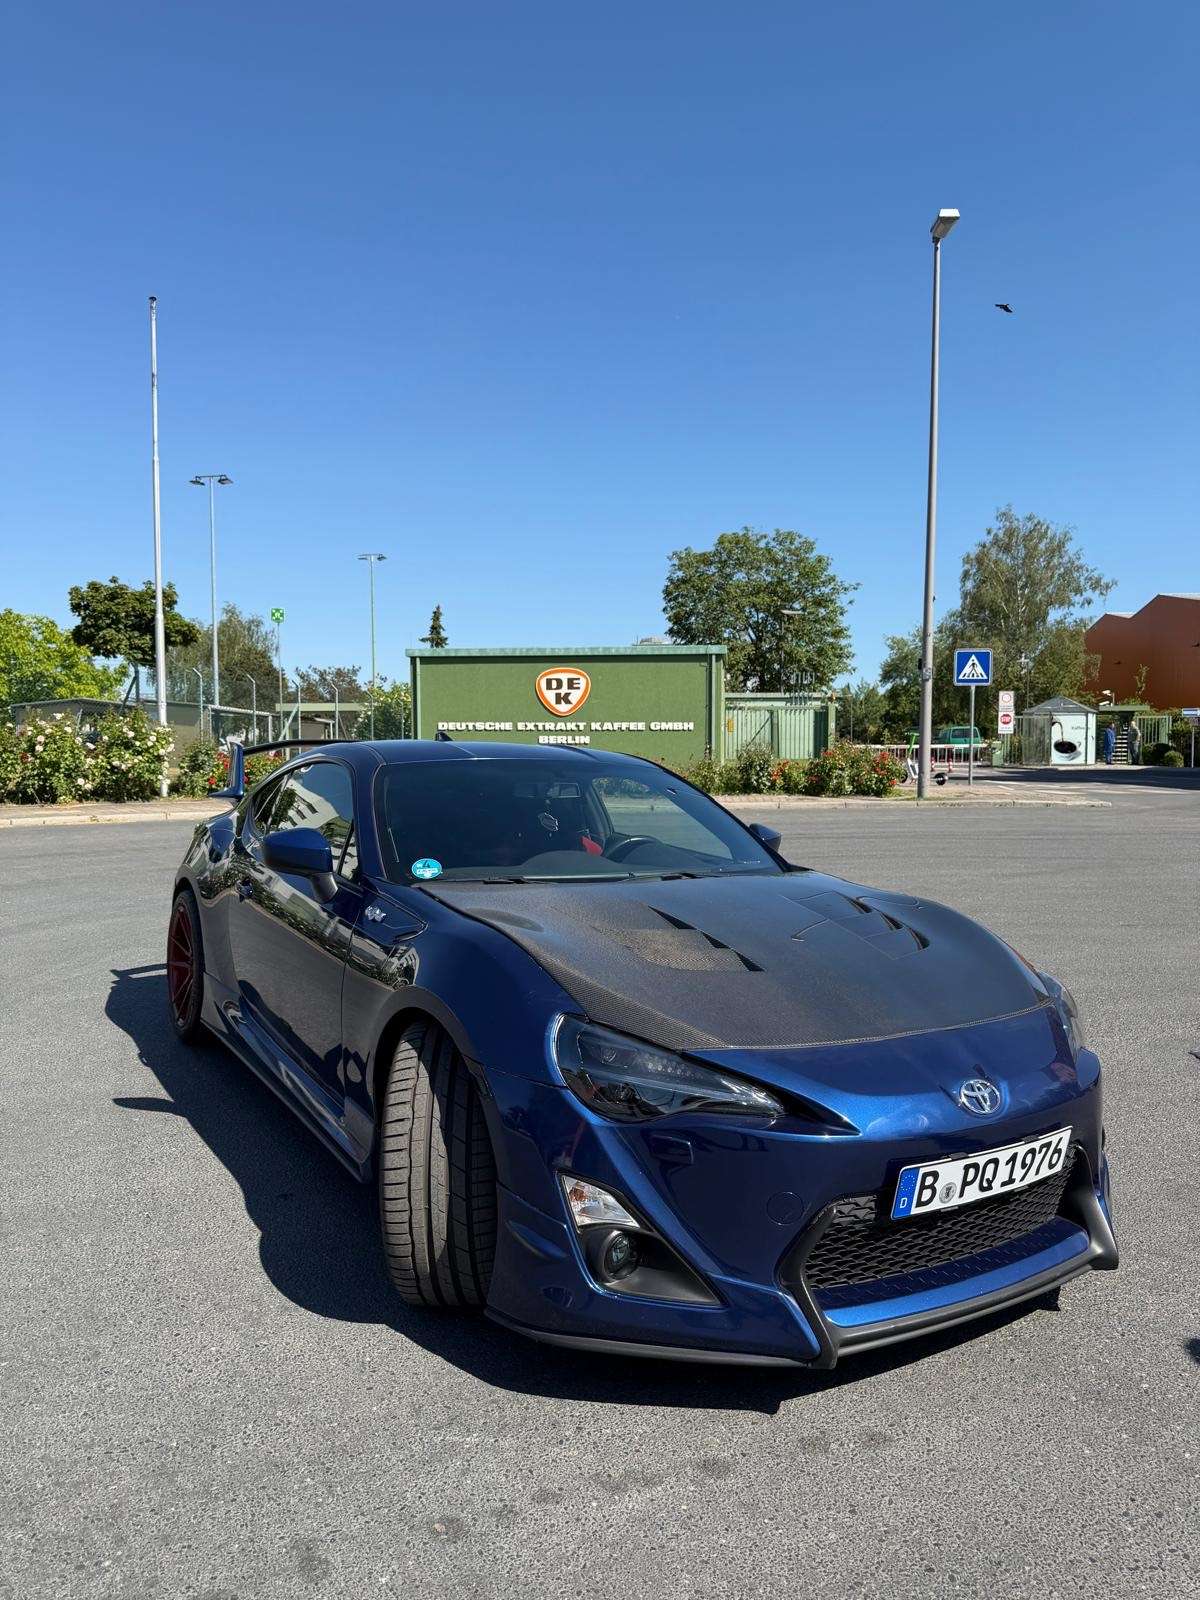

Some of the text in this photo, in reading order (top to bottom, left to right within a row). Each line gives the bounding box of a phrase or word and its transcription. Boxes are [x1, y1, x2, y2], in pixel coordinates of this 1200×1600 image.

[545, 677, 581, 691] DE
[554, 692, 573, 705] K
[437, 721, 694, 731] DEUTSCHE EXTRAKT KAFFEE GMBH
[538, 735, 591, 744] BERLIN
[915, 1136, 1064, 1208] B PQ 1976
[899, 1197, 908, 1209] D
